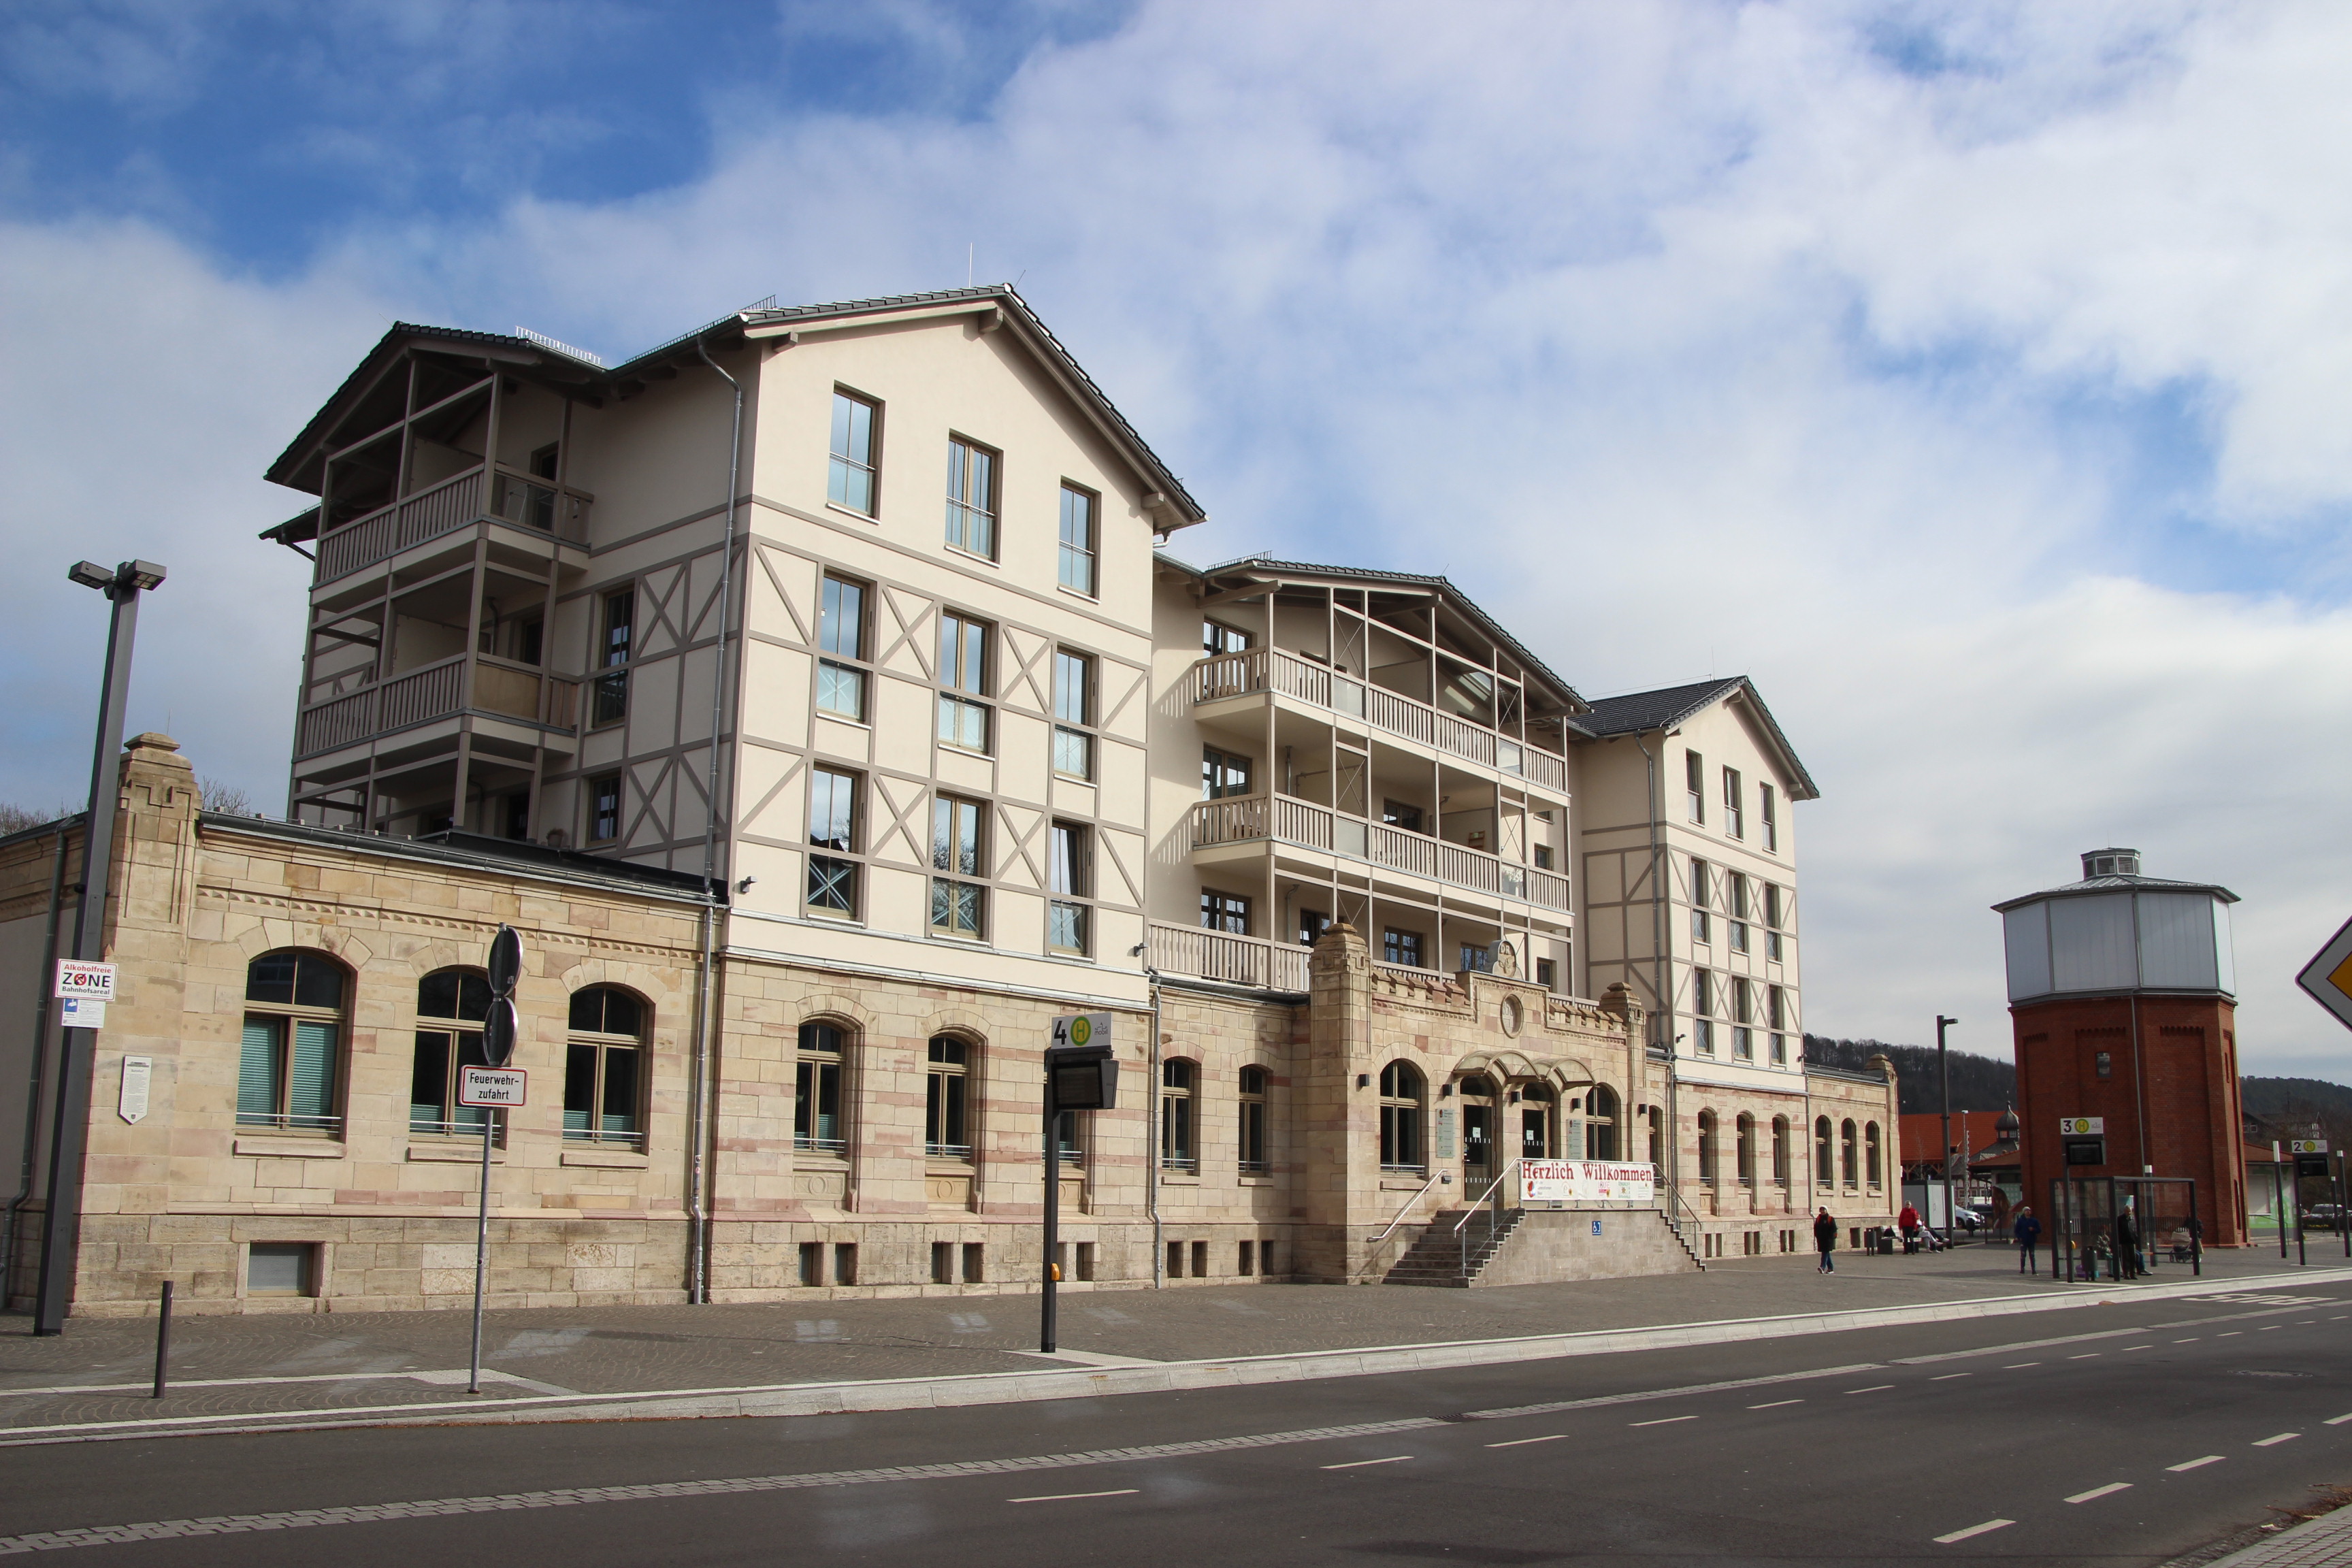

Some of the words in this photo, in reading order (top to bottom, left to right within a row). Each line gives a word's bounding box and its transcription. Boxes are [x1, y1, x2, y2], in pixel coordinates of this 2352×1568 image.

[1500, 943, 1511, 955] DR
[64, 964, 112, 973] Alkoholfreie
[62, 986, 110, 995] Bahnhofsareal
[1054, 1020, 1066, 1045] 4
[1077, 1023, 1085, 1039] H
[470, 1073, 519, 1085] Feuerwehr-
[478, 1088, 509, 1100] zufahrt
[2063, 1120, 2072, 1132] 3
[2078, 1122, 2085, 1130] H
[2293, 1141, 2302, 1152] 2
[1522, 1161, 1574, 1179] Herzlich
[1582, 1163, 1652, 1181] Willkommen
